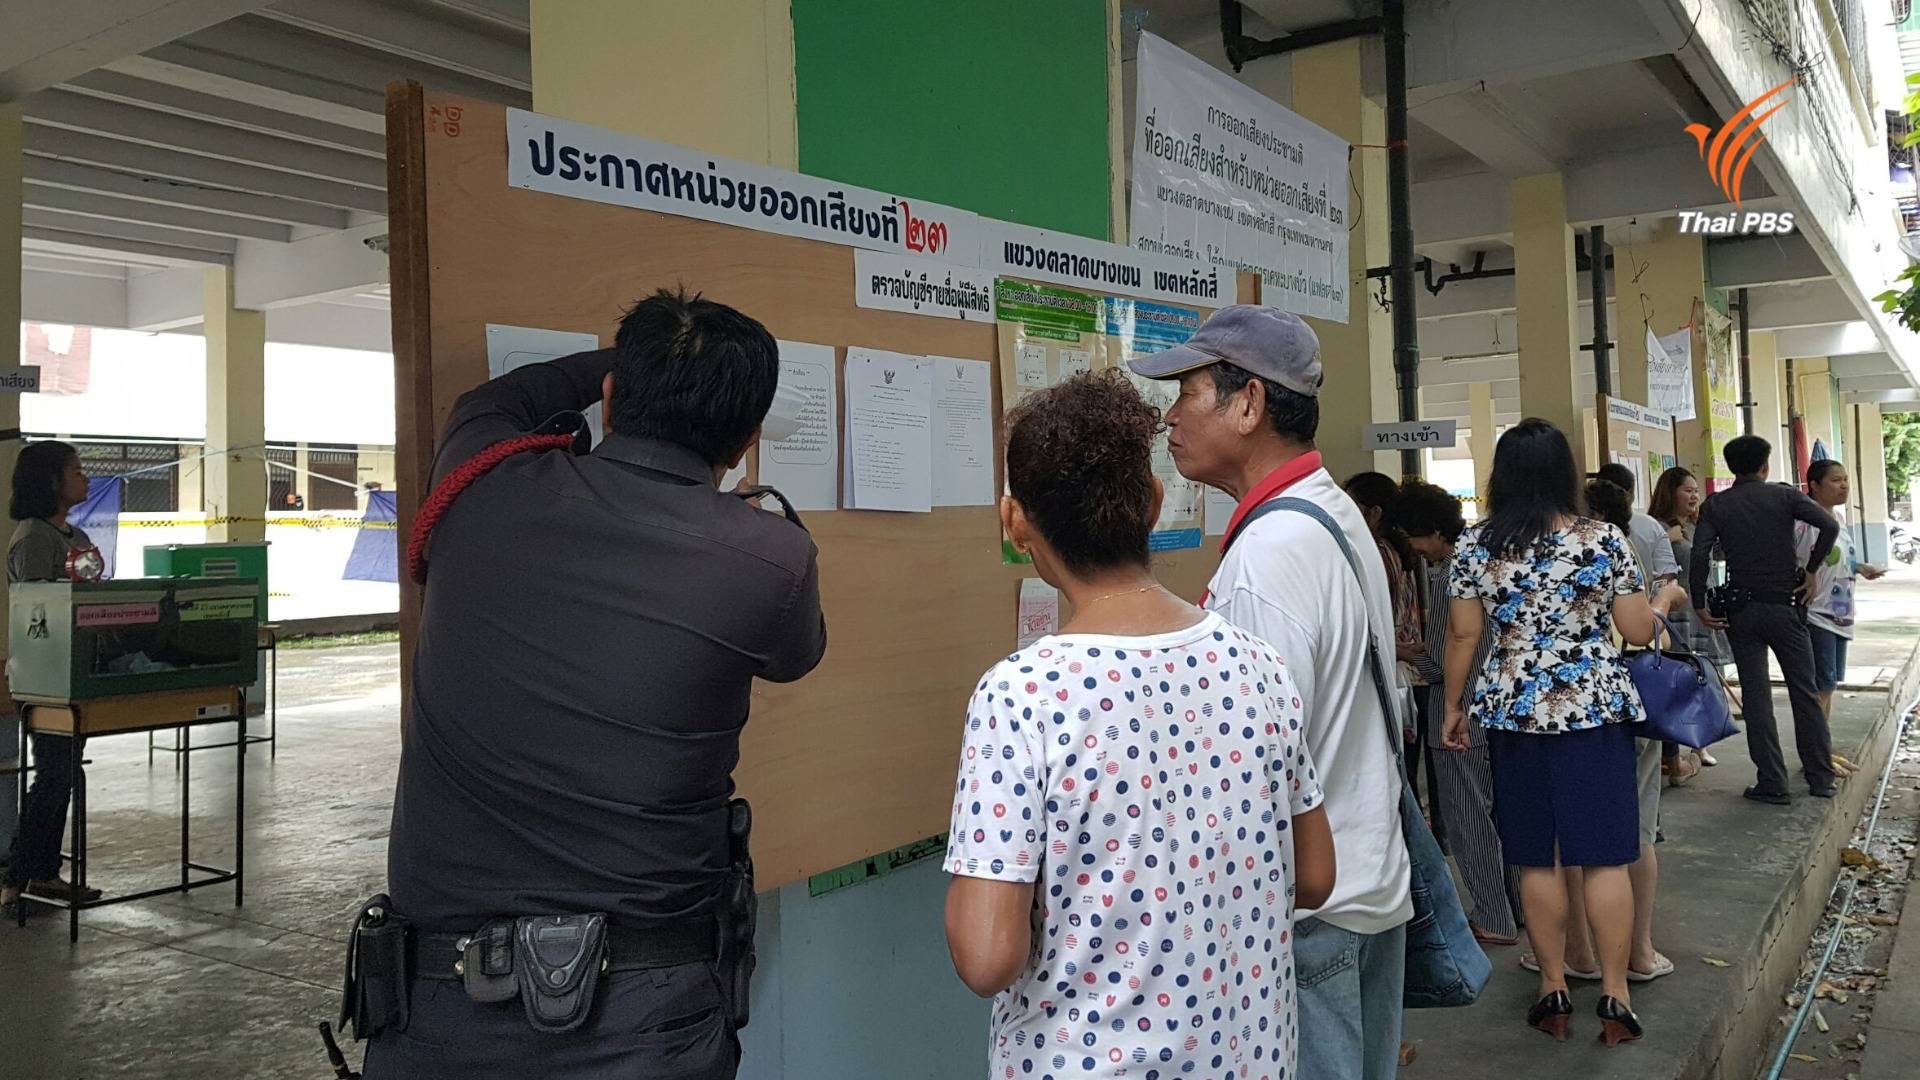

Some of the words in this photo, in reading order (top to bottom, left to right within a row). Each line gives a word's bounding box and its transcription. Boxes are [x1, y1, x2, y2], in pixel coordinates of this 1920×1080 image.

[1145, 107, 1328, 218] ที่ออกเสียงสำหรับหน่วยออกเสียงที่
[1208, 106, 1304, 166] การออกเสียงประชามติ
[528, 131, 899, 244] ประกาศหน่วยออกเสียงที่
[1157, 184, 1234, 222] แขวงตลาดบางเขน
[1004, 241, 1141, 288] แขวงตลาดบางเขน
[1154, 266, 1218, 299] เขตหลักสี่
[1376, 426, 1440, 443] ทางเข้า
